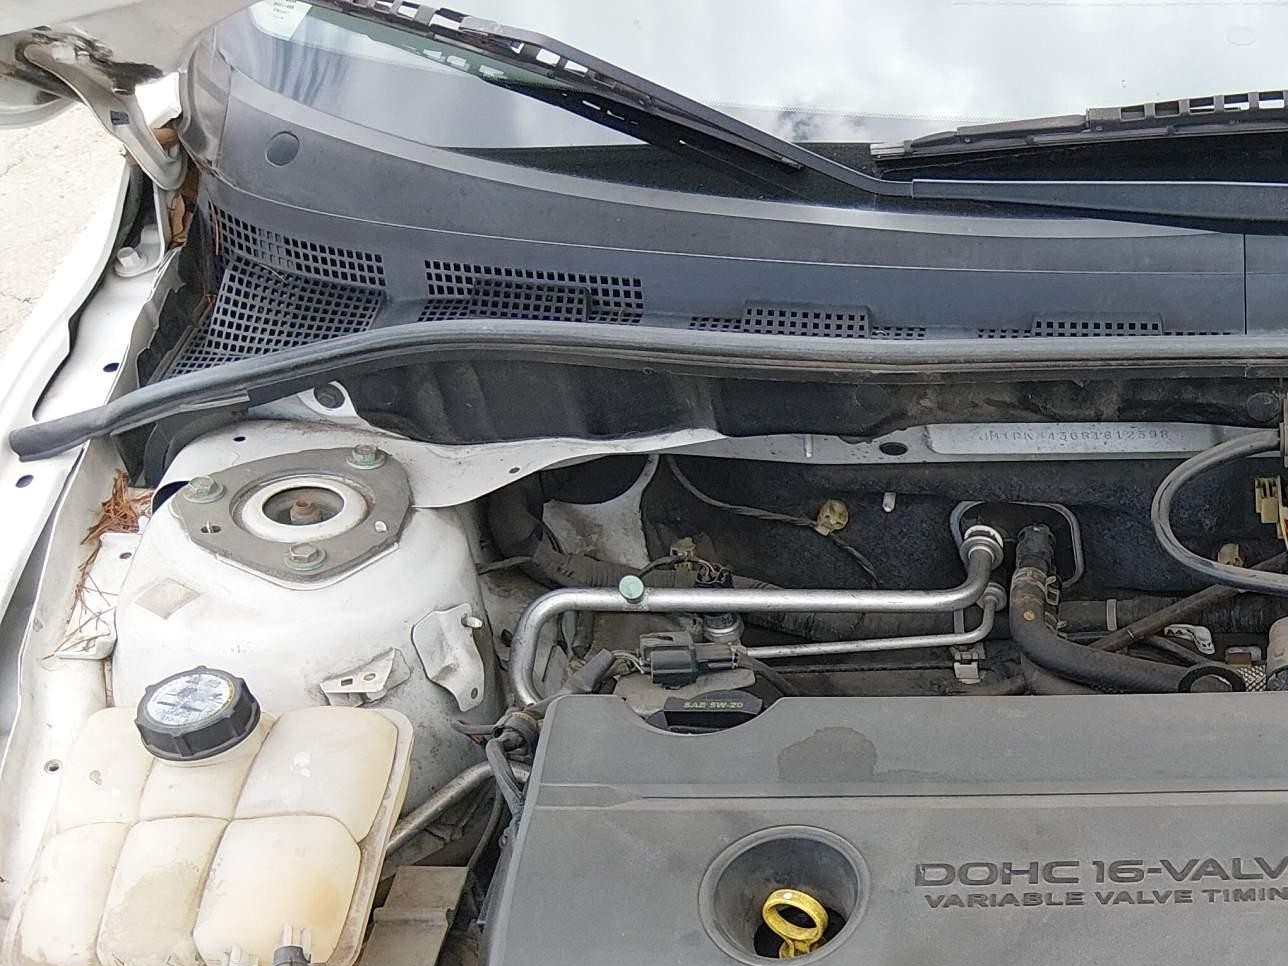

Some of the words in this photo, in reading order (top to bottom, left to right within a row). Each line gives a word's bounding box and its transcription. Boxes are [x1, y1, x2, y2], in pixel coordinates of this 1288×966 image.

[683, 701, 707, 709] SAE
[709, 701, 744, 709] 5W-20
[914, 859, 1081, 887] DOHC
[924, 890, 1086, 909] VARIABLE
[1094, 888, 1193, 906] VALVE
